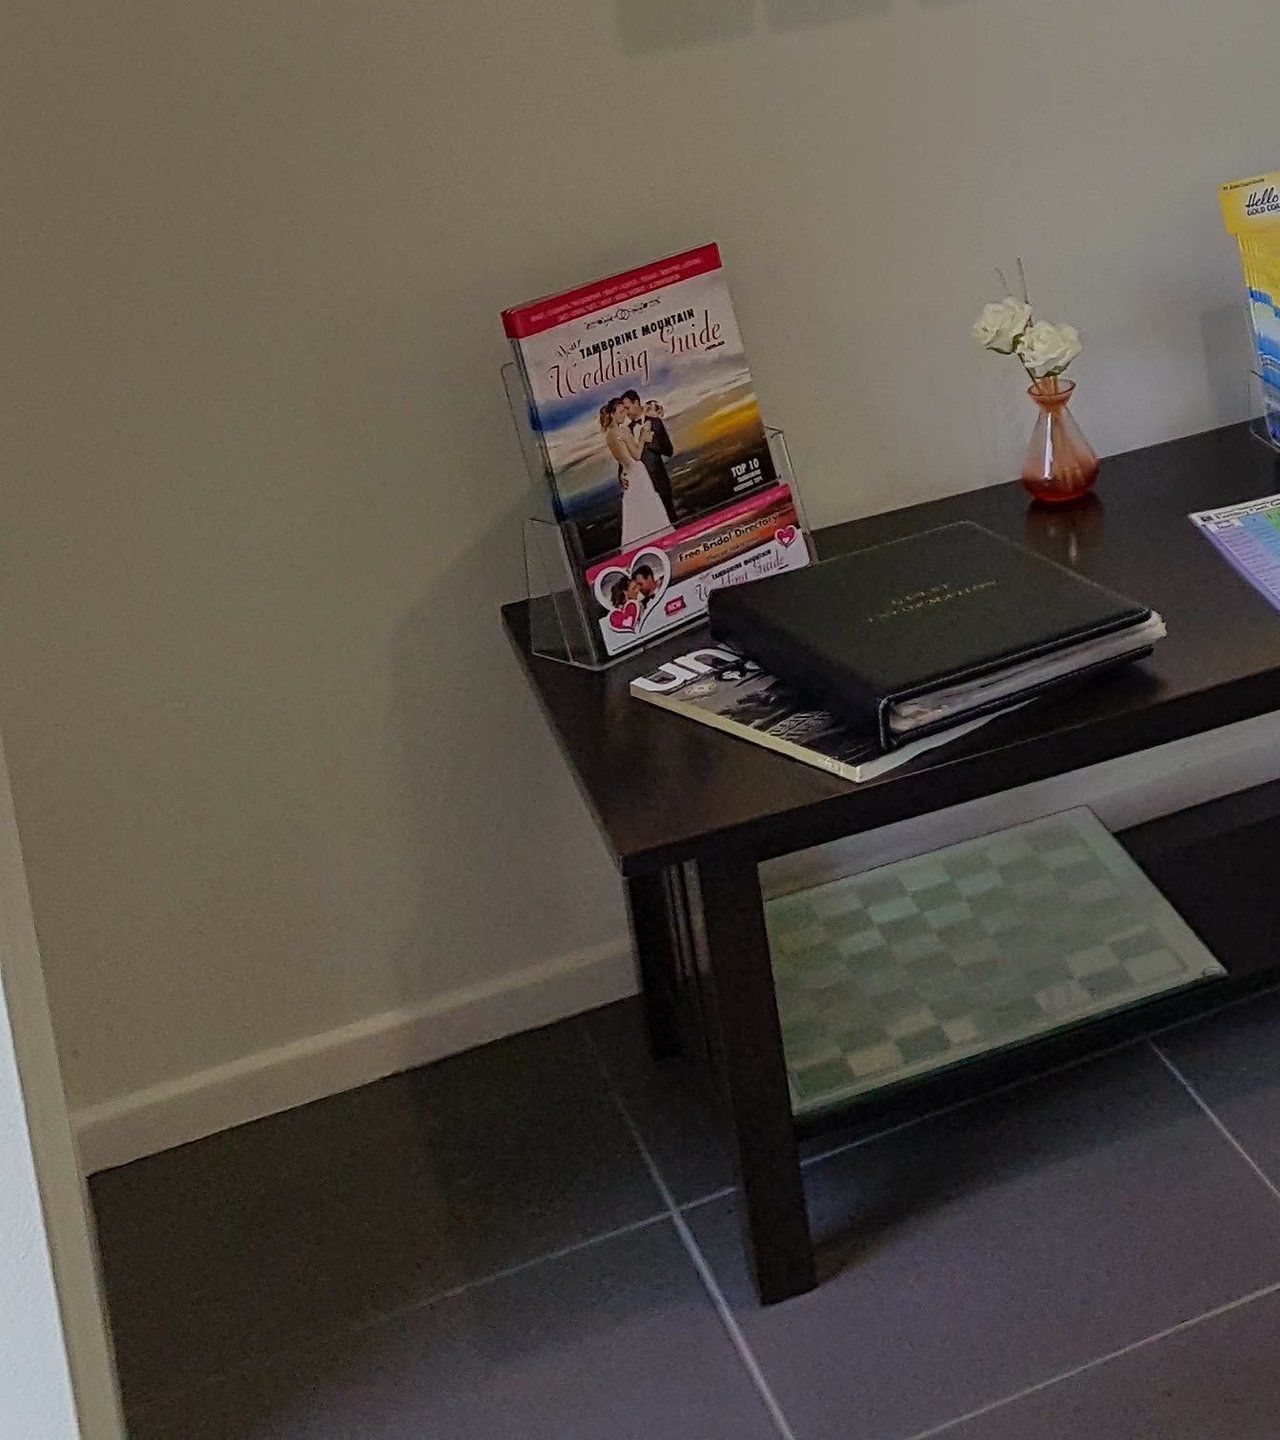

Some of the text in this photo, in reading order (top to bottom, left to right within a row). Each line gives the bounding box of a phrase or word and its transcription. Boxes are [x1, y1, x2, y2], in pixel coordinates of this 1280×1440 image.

[1244, 186, 1279, 209] Hello
[1246, 206, 1266, 217] GOLD
[578, 308, 696, 360] TAMBORINE MOUNTAIN
[549, 310, 722, 399] Wedding Guide
[730, 462, 747, 476] TOP
[678, 513, 780, 563] Free Bridal Directory
